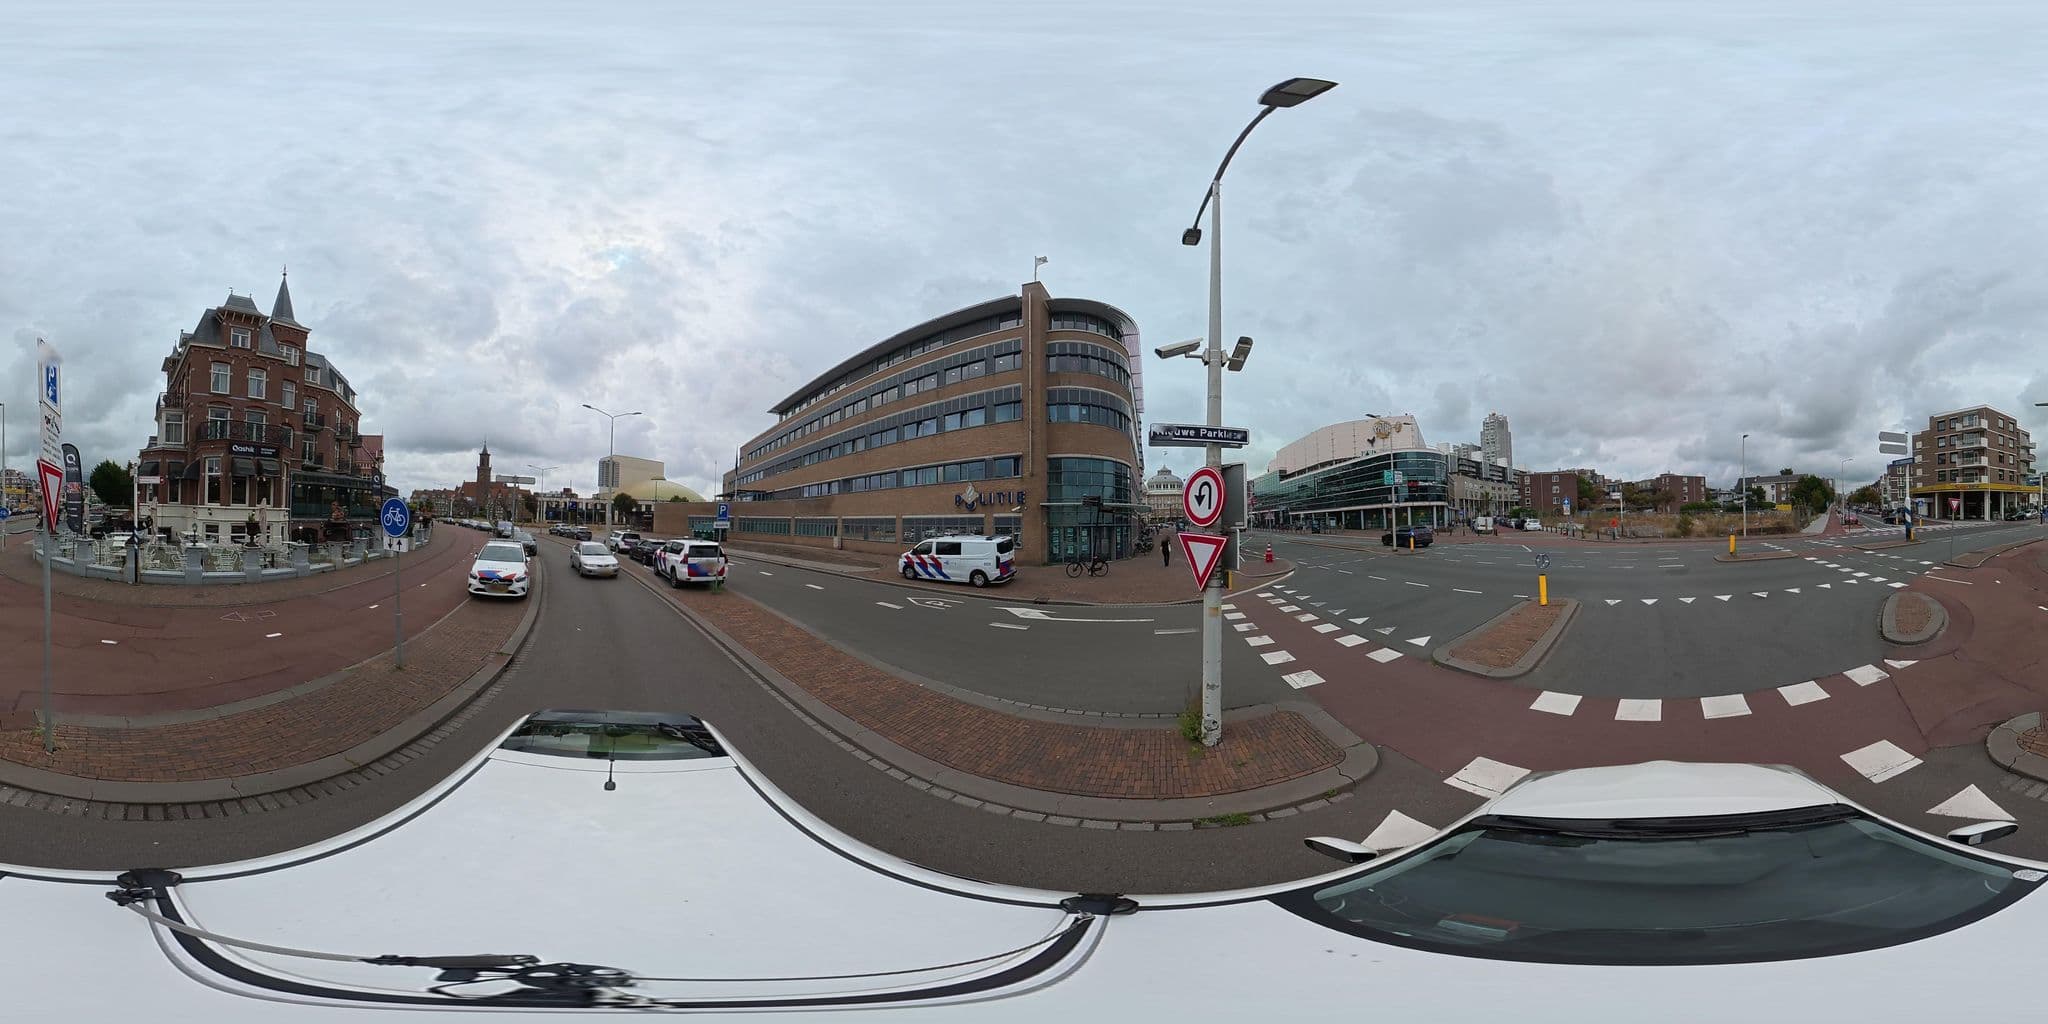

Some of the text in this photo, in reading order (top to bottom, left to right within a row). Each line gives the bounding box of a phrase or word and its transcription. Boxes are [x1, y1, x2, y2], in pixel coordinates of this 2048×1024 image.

[1200, 428, 1244, 440] Parkl
[232, 444, 255, 453] Qashik
[720, 505, 726, 515] P
